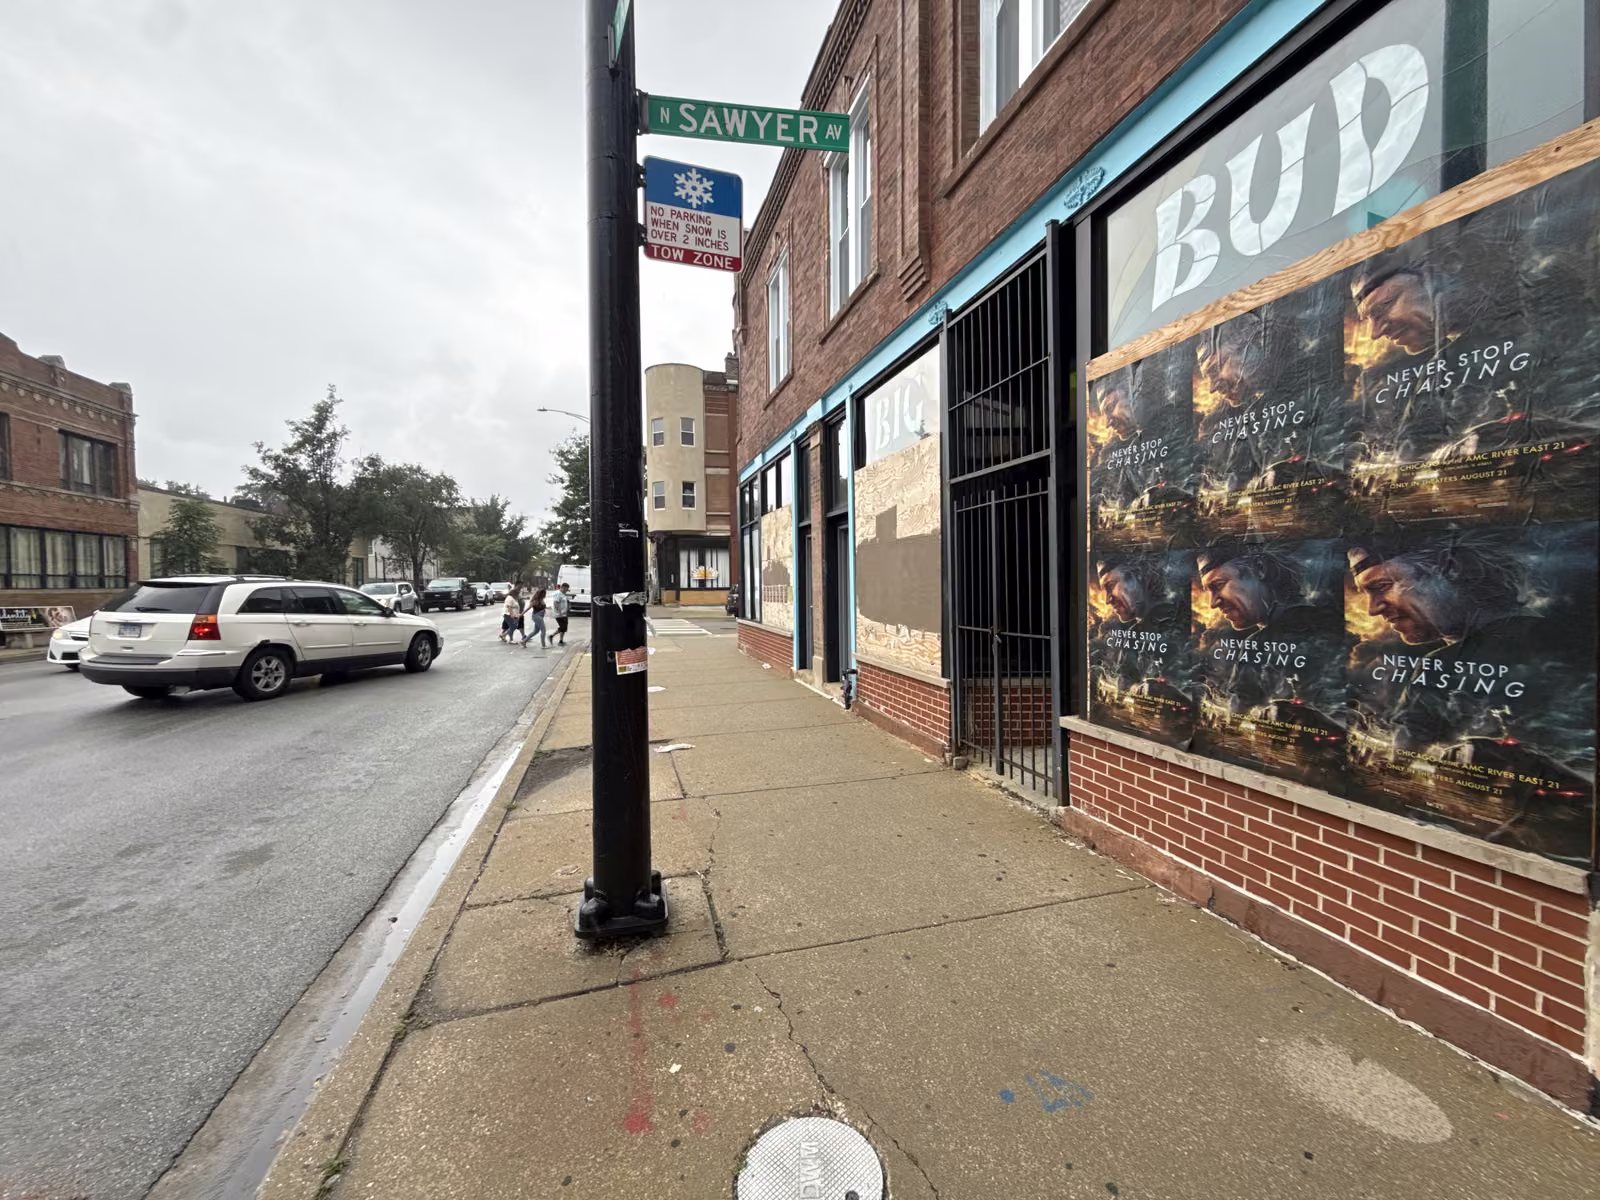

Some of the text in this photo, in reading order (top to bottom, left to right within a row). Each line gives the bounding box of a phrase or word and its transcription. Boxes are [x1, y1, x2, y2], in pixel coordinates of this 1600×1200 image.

[660, 103, 842, 144] N SAWYER AV
[1152, 43, 1429, 313] BUD
[650, 206, 712, 226] NO PARKING
[651, 218, 727, 240] WHEN SNOW IS
[651, 229, 729, 251] OVER 2 INCHES
[651, 244, 734, 270] TOW ZONE
[1387, 341, 1514, 386] NEVER STOP
[1375, 353, 1530, 404] CHASING
[875, 374, 924, 451] BIG
[1219, 401, 1296, 429] NEVER STOP
[1212, 410, 1305, 444] CHASING
[1107, 446, 1168, 469] CHASING
[1112, 439, 1162, 458] NEVER STOP
[1400, 460, 1441, 472] CHICAGO
[1465, 453, 1489, 462] AMC
[1491, 448, 1519, 458] RIVER
[1523, 443, 1549, 454] EAST
[1553, 441, 1565, 450] 21
[1390, 482, 1409, 490] ONLY
[1460, 470, 1495, 480] AUGUST
[1106, 637, 1168, 653] CHASING
[1112, 629, 1162, 641] NEVER STOP
[1220, 638, 1297, 653] NEVER STOP
[1213, 649, 1306, 668] CHASING
[1383, 653, 1509, 678] NEVER STOP
[1372, 666, 1525, 698] CHASING
[1285, 723, 1302, 731] RIVER
[1303, 726, 1319, 734] EAST
[1386, 763, 1405, 772] ONLY
[1455, 779, 1491, 792] AUGUST
[1493, 787, 1503, 795] 21
[1396, 749, 1436, 762] CHICAGO
[1462, 763, 1485, 773] AMC
[1487, 768, 1515, 779] RIVER
[1518, 774, 1544, 785] EAST
[1547, 781, 1560, 789] 21
